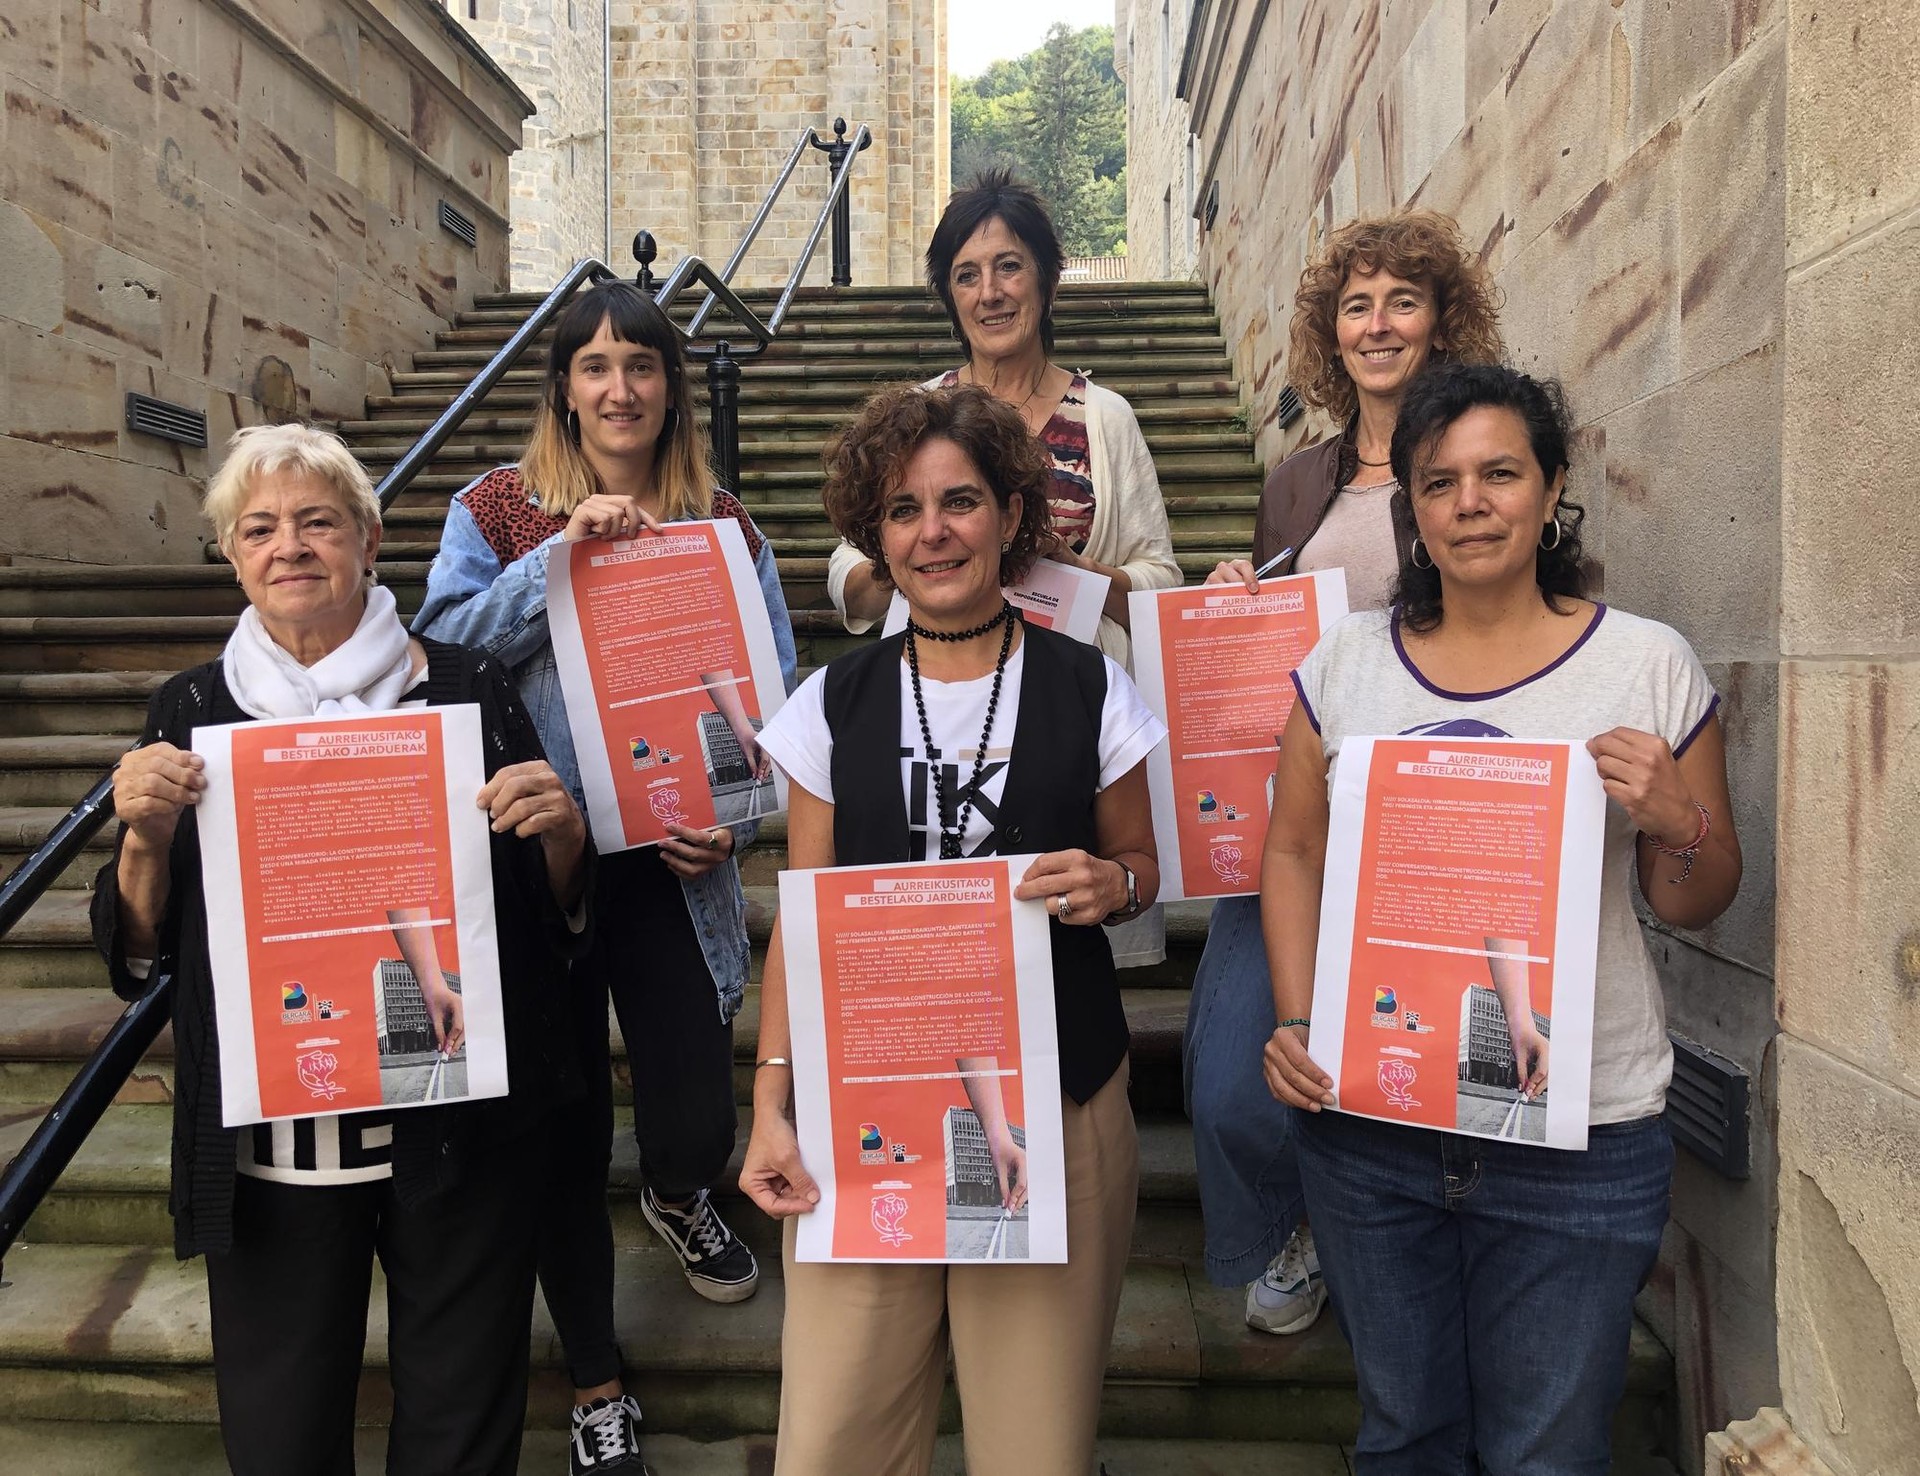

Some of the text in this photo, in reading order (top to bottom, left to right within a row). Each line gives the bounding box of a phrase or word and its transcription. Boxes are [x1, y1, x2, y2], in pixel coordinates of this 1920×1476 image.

[630, 535, 705, 550] AURREIKUSITAKO
[604, 544, 710, 564] BESTELAKO JARDUERAK
[1222, 592, 1300, 606] AURREIKUSITAKO
[1194, 602, 1304, 618] BESTELAKO JARDUERAK
[318, 731, 422, 744] AURREIKUSITAKO
[281, 743, 426, 760] BESTELAKO JARDUERAK
[1447, 755, 1548, 769] AURREIKUSITAKO
[1412, 765, 1549, 783] BESTELAKO JARDUERAK
[894, 879, 990, 891] AURREIKUSITAKO
[860, 891, 994, 906] BESTELAKO JARDUERAK
